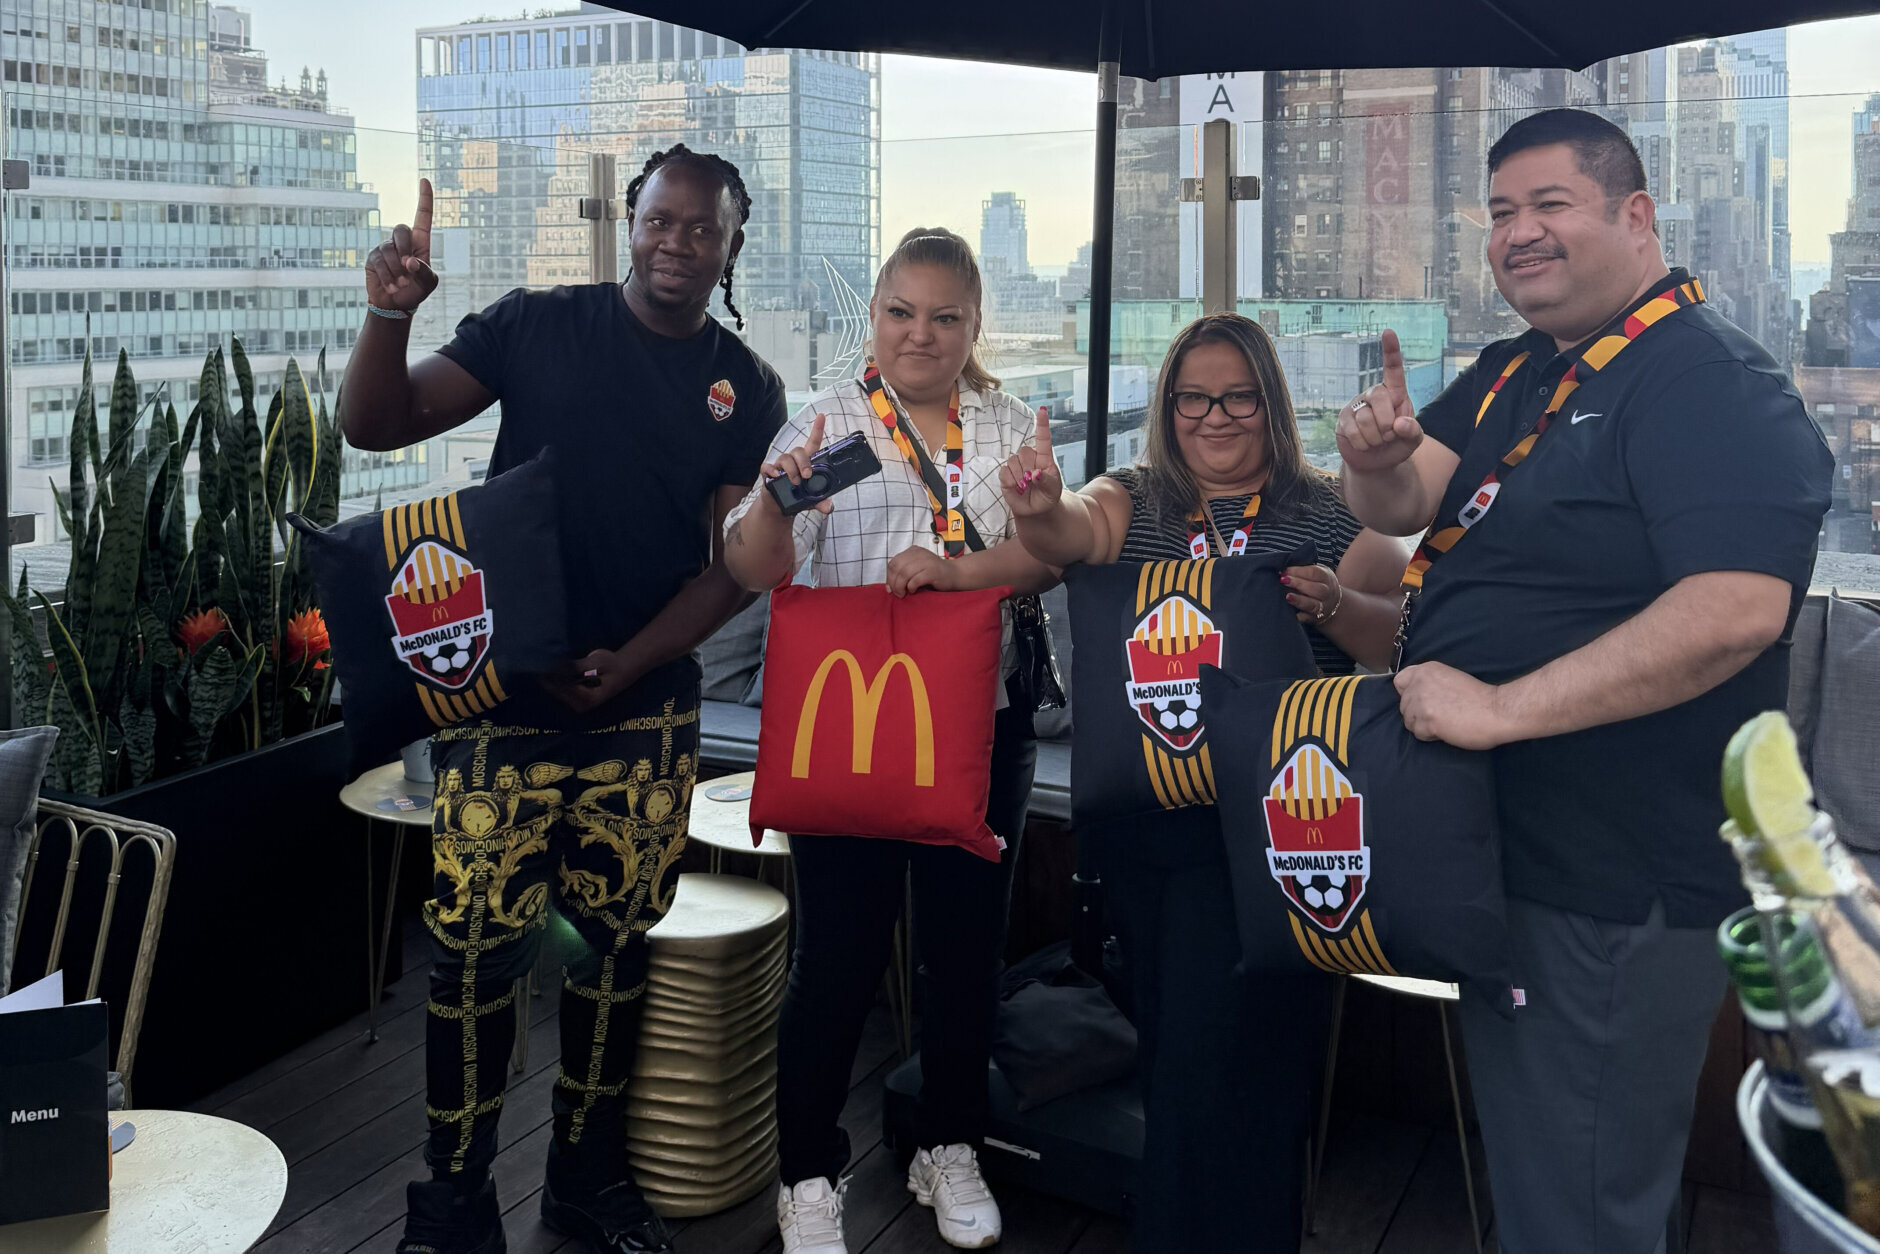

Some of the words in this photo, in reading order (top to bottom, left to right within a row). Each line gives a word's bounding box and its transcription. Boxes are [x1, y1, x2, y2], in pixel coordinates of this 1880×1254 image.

[1207, 72, 1235, 114] A
[399, 623, 472, 653] McDONALD'S
[473, 617, 487, 632] FC
[472, 737, 490, 788] MOSCHINO
[660, 727, 673, 777] MOSCHINO
[1273, 855, 1346, 871] McDONALD'S
[1348, 855, 1363, 871] FC
[468, 895, 486, 943] MOSCHINO
[462, 1016, 478, 1062] MOSCHINO
[593, 1001, 612, 1043] MOSCHINO
[463, 1063, 478, 1109] MOSCHINO
[586, 1045, 605, 1088] MOSCHINO
[11, 1108, 59, 1124] Menu
